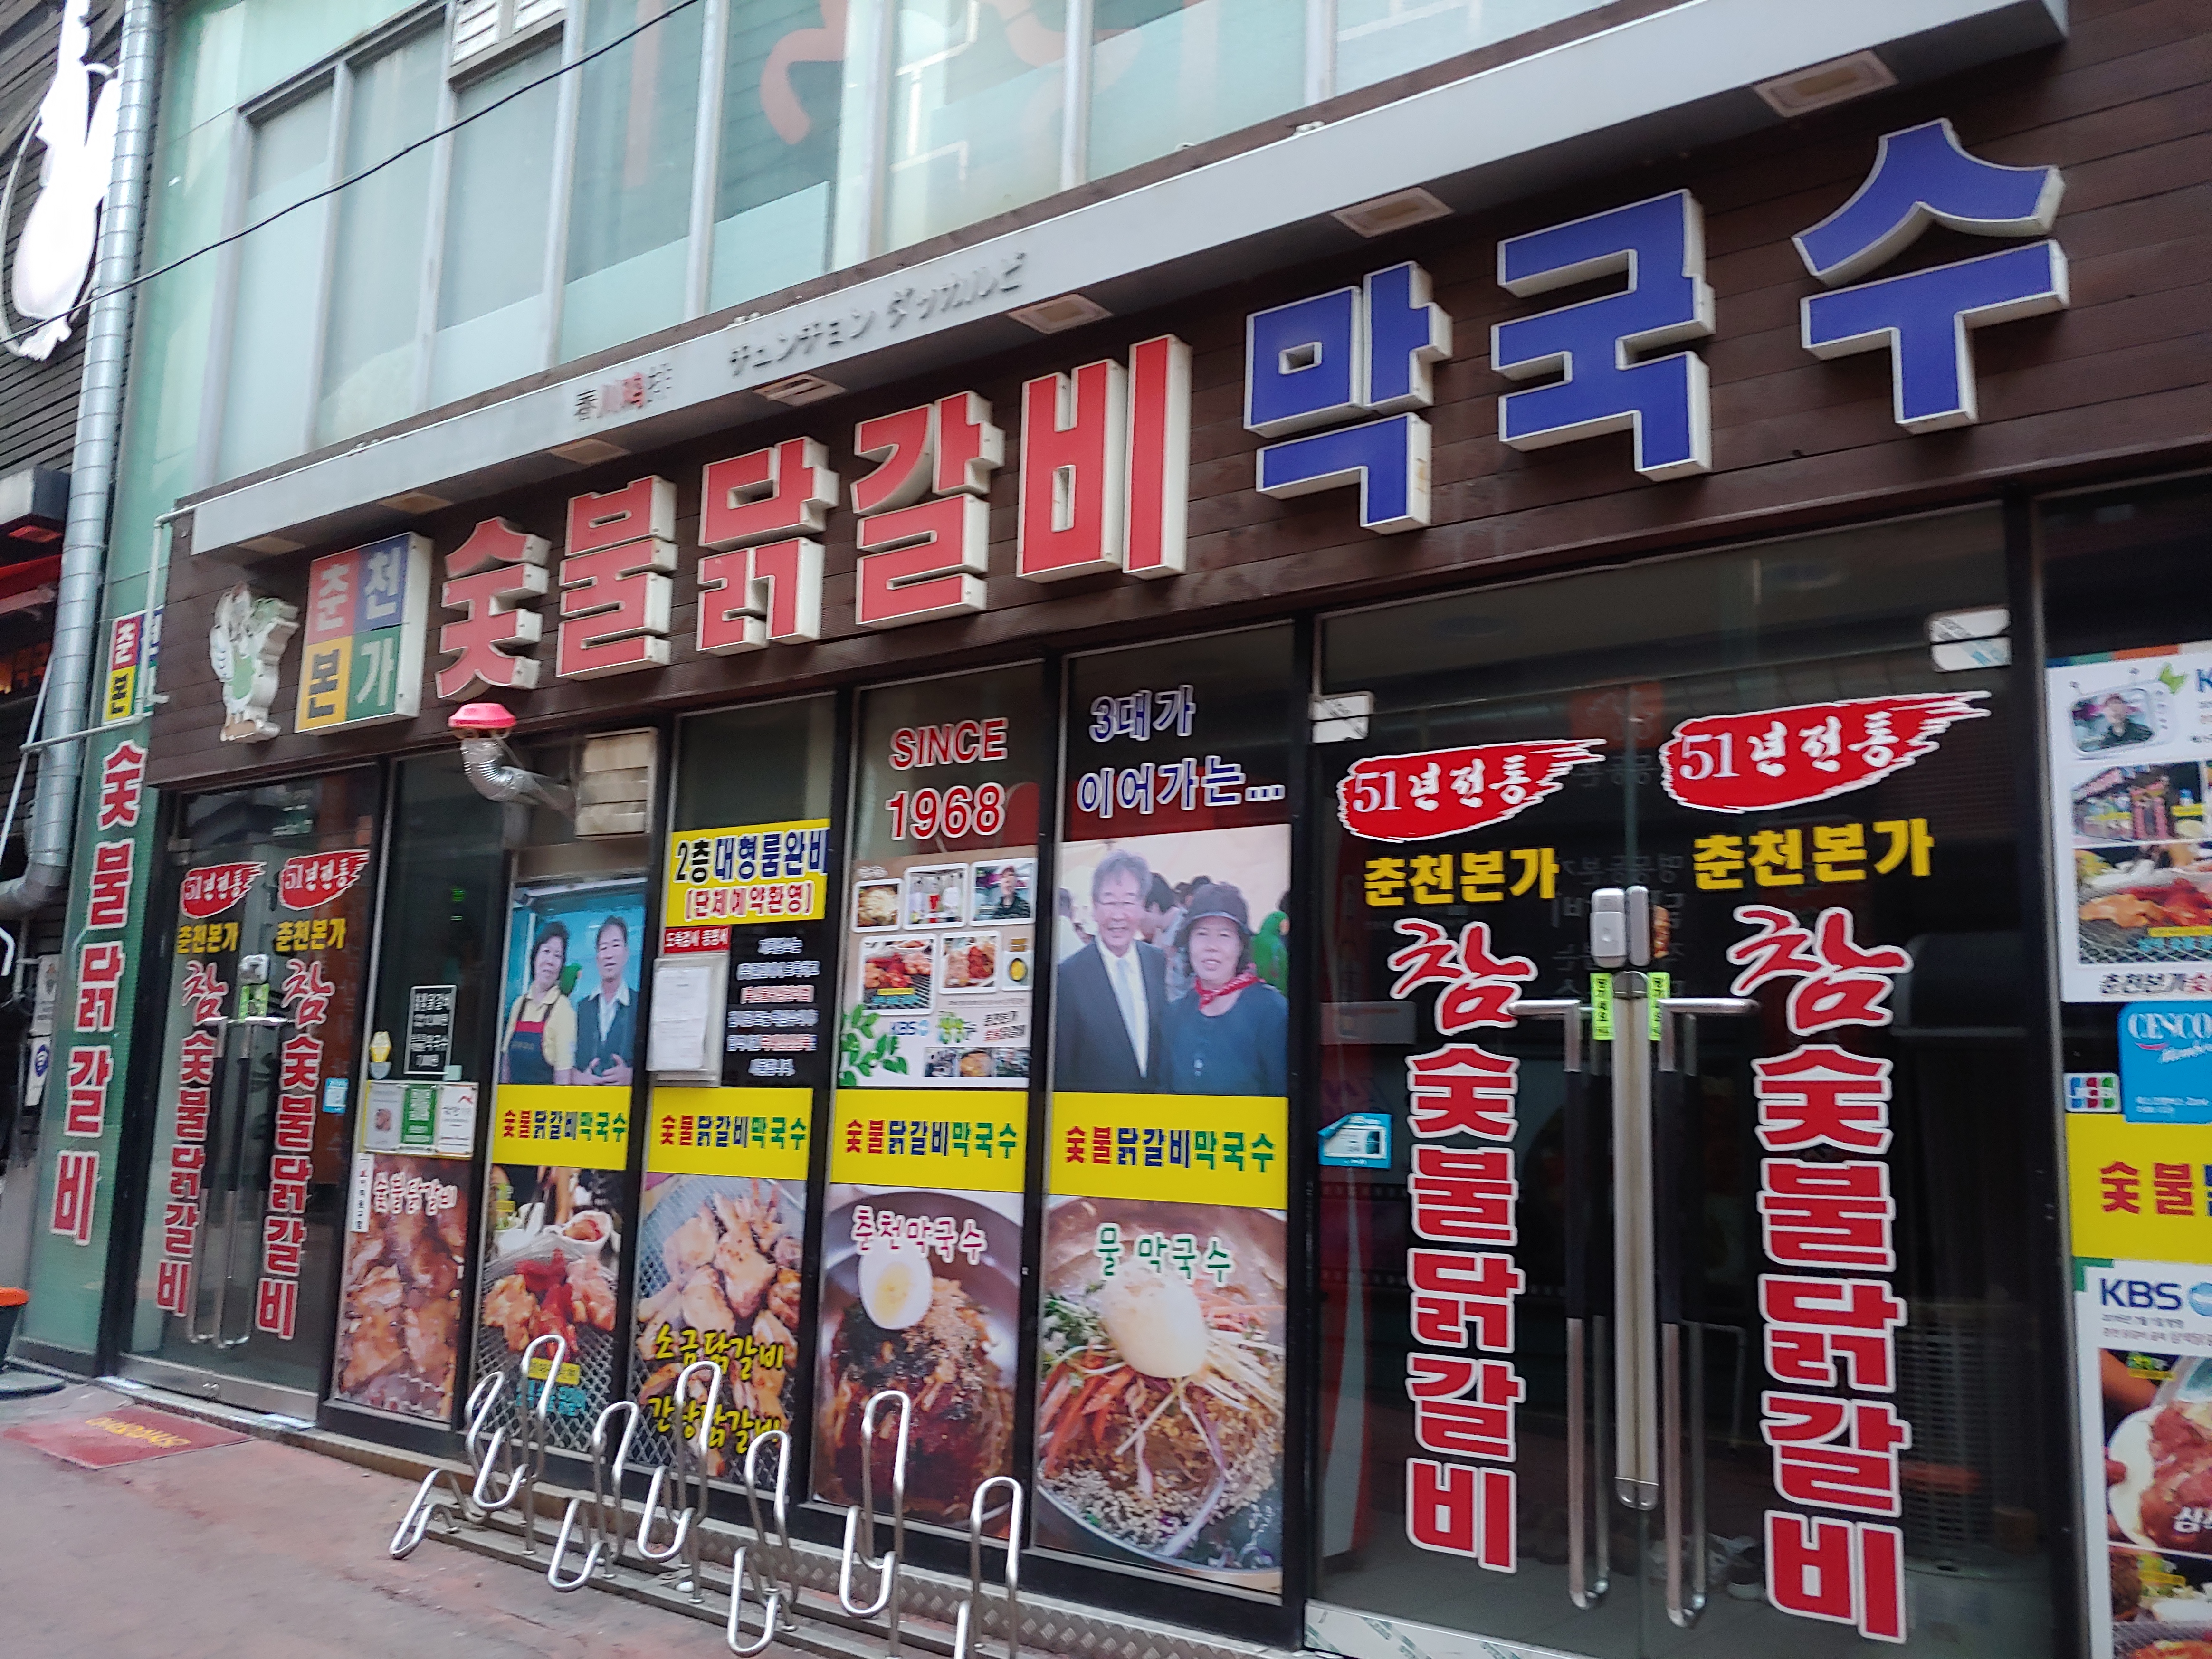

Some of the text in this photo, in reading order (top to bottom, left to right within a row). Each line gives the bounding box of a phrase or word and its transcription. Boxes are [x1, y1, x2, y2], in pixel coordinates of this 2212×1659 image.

[435, 117, 2070, 700] 숯불닭갈비 막국수
[1089, 683, 1197, 743] 3대가
[888, 717, 1009, 771] SINCE
[885, 782, 1005, 841] 1968
[1363, 847, 1561, 907] 춘천본가
[1692, 817, 1935, 891] 춘천본가
[50, 739, 148, 1246] 숯불닭갈비
[1134, 1231, 1235, 1288] 막국수
[2099, 1277, 2184, 1310] KBS
